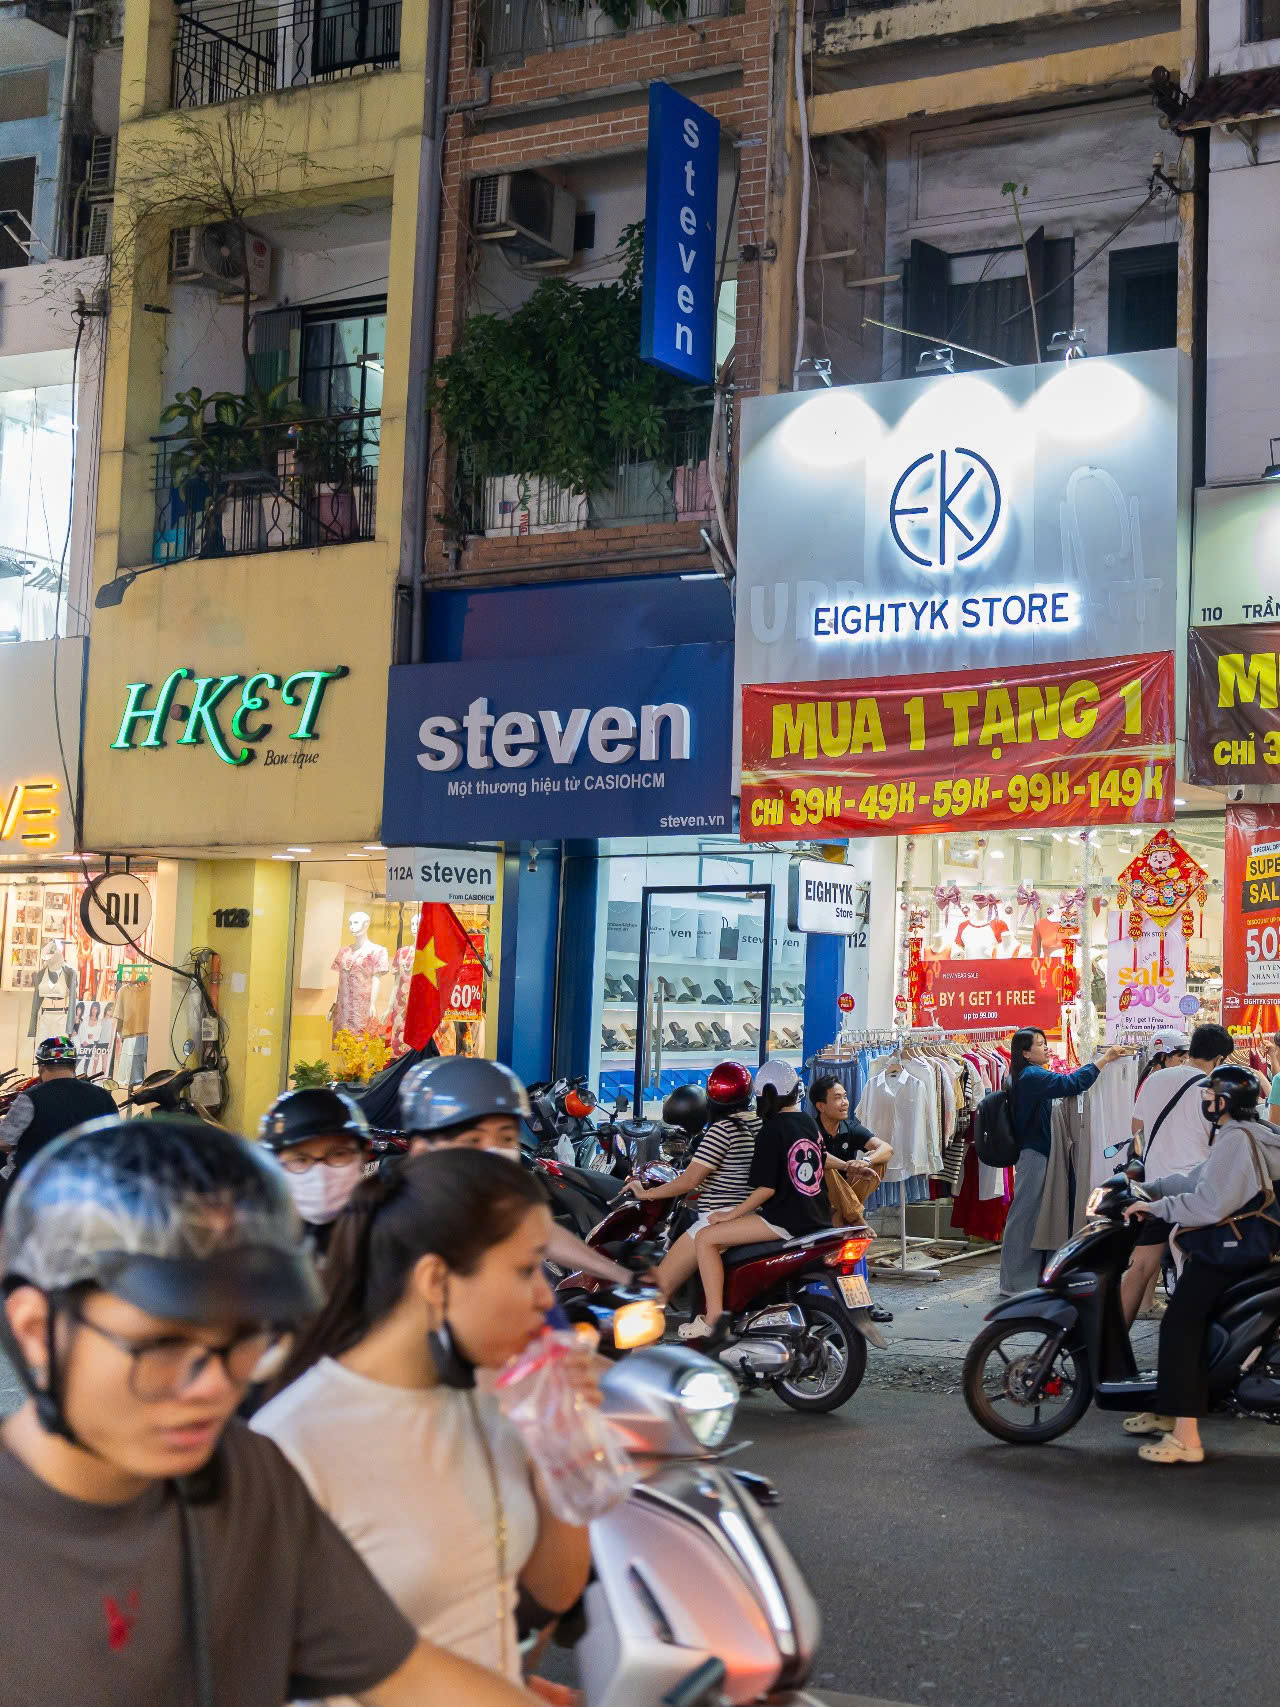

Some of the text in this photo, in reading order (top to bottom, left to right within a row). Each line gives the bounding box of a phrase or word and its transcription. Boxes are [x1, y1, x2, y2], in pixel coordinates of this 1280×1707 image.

[675, 118, 700, 356] steven
[814, 599, 949, 636] EIGHTYK
[962, 592, 1070, 629] STORE
[1202, 607, 1223, 622] 110
[771, 677, 1143, 761] MUA 1 TẶNG 1
[416, 696, 692, 773] steven
[448, 772, 666, 798] Một thương hiệu từ CASIOHCM
[659, 812, 725, 829] steven.vn
[388, 861, 492, 885] 112A steven
[448, 893, 464, 901] From
[804, 878, 853, 905] EIGHTYK
[835, 907, 853, 919] Store
[741, 933, 778, 946] stevn
[847, 932, 867, 949] 112
[450, 984, 481, 1009] 60%
[939, 992, 956, 1007] BY
[958, 991, 965, 1006] 1
[969, 991, 992, 1006] GET
[996, 991, 1001, 1005] 1
[1006, 990, 1036, 1005] FREE
[963, 1013, 972, 1021] up
[979, 1011, 998, 1020] 99.000
